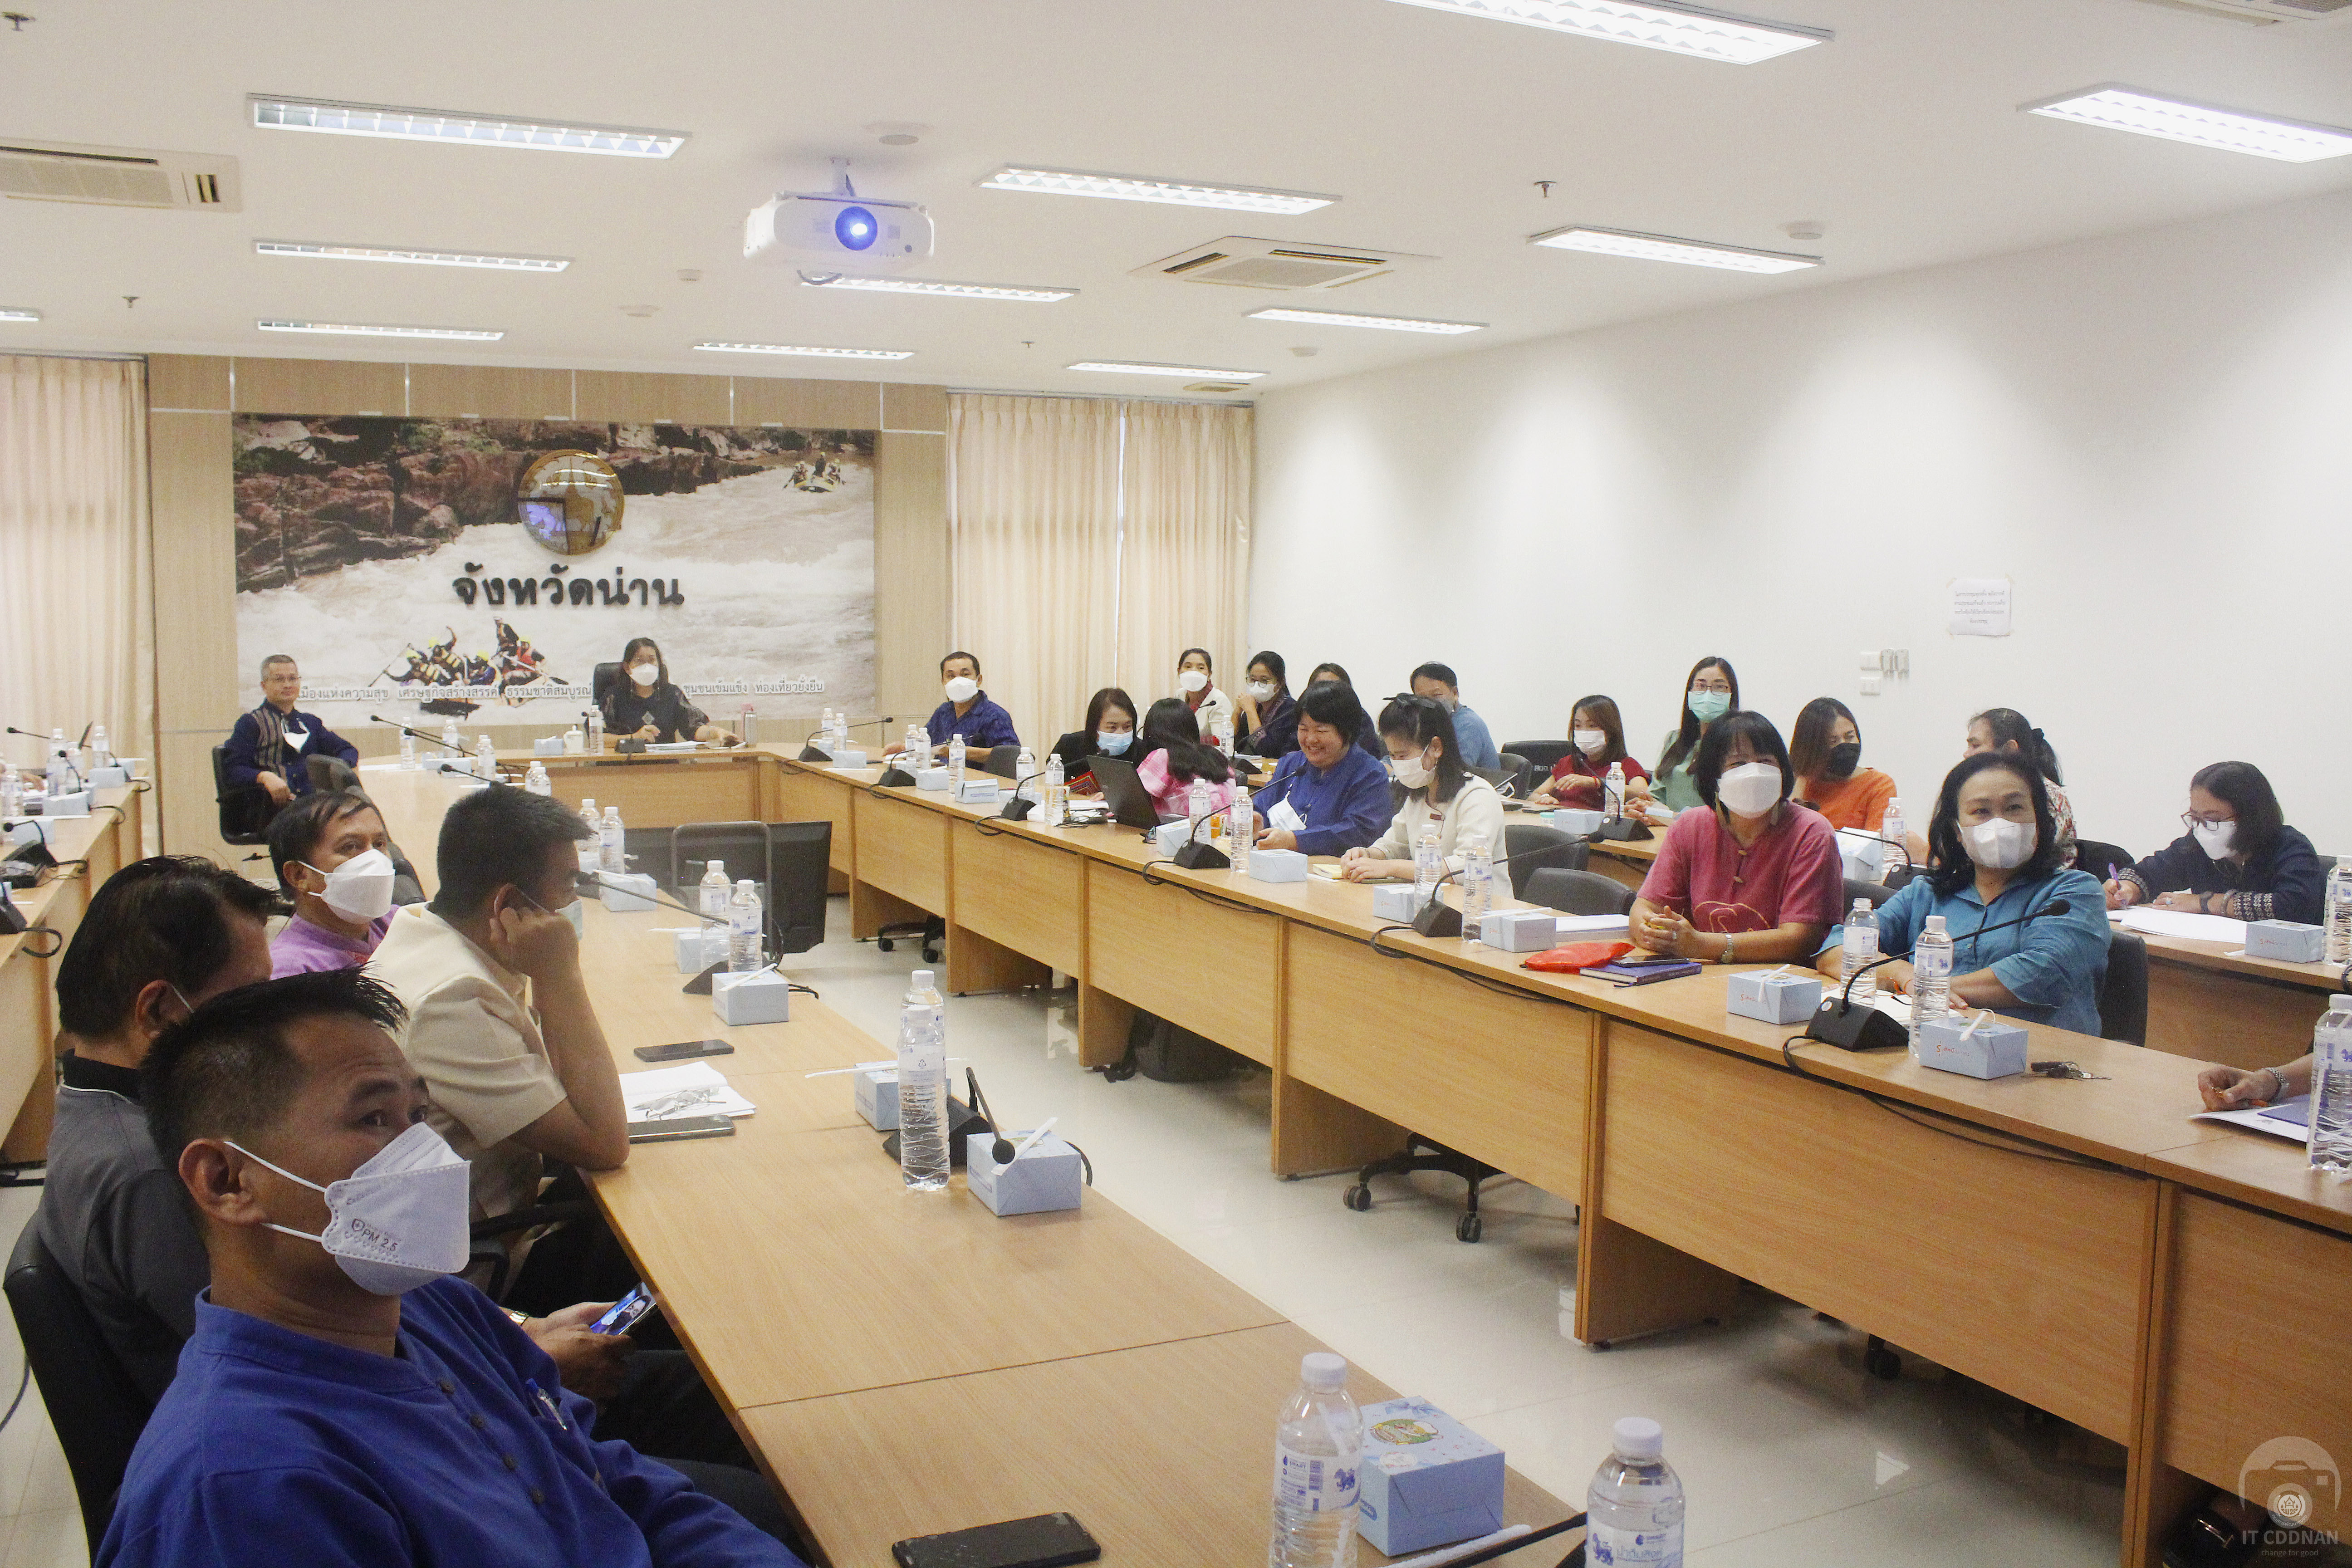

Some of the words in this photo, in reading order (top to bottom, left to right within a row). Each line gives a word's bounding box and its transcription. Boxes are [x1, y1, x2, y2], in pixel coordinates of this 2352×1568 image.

[452, 562, 685, 605] จังหวัดน่าน
[298, 686, 388, 702] มืองแห่งความสุข
[507, 683, 593, 699] ธรรมชาติสมบูรณ์
[683, 679, 747, 697] ชุมชนเข้มแข็ง
[755, 677, 823, 693] ท่องเที่ยวยั่งยืน
[362, 1228, 380, 1244] PM
[380, 1239, 398, 1251] 2.5
